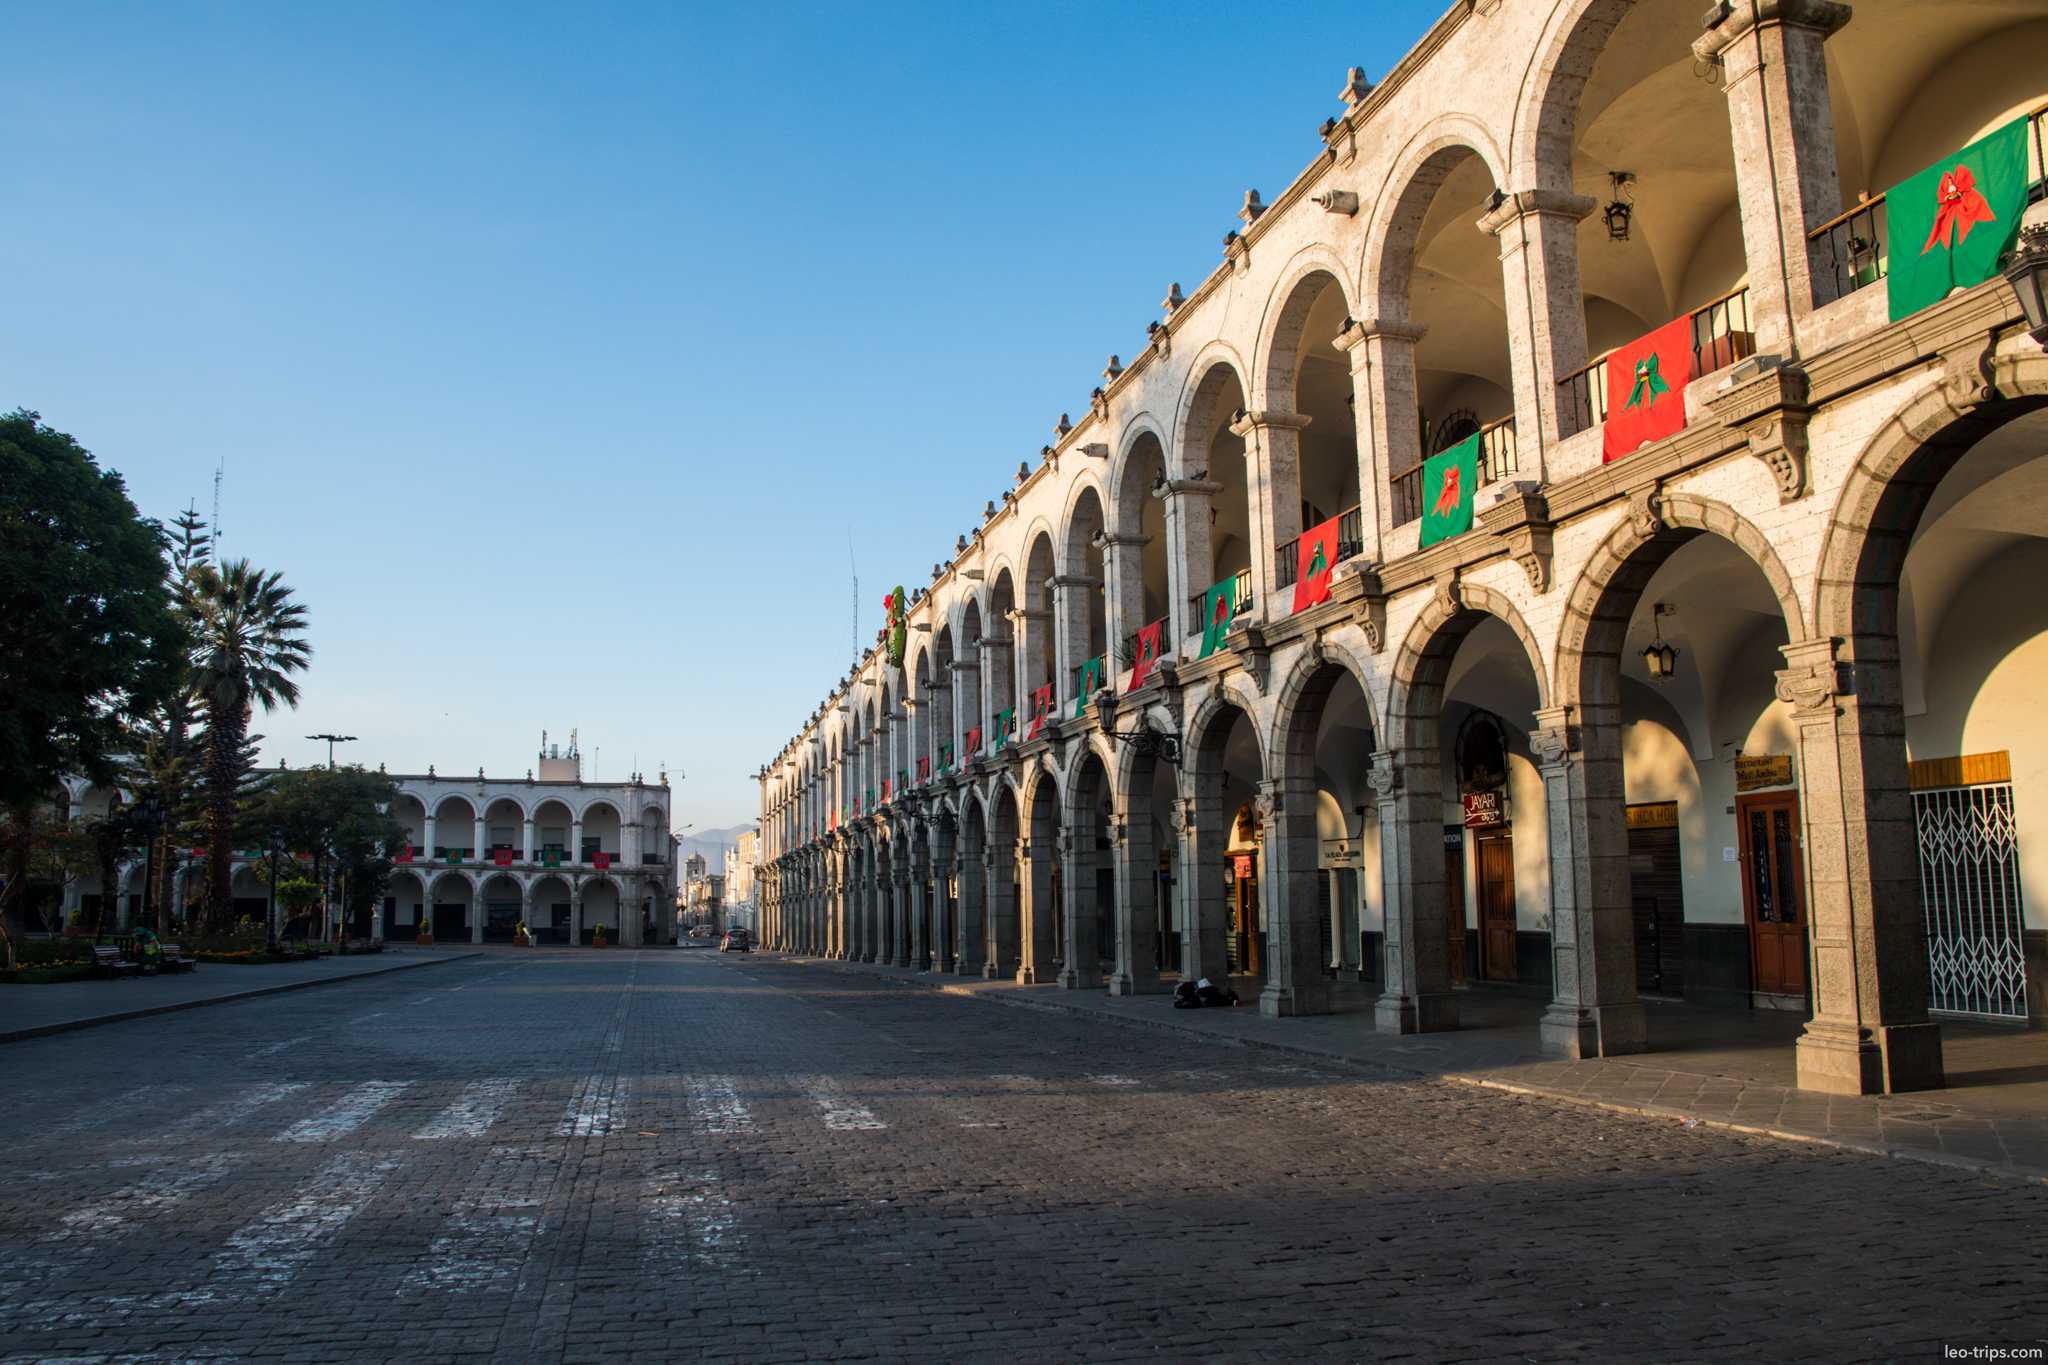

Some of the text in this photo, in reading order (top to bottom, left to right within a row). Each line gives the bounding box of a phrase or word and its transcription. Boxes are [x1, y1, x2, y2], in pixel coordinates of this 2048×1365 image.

[1736, 758, 1773, 769] RESTAURANT
[1470, 793, 1495, 810] JAYARI
[1633, 809, 1655, 824] INCA
[1657, 807, 1677, 822] HOU
